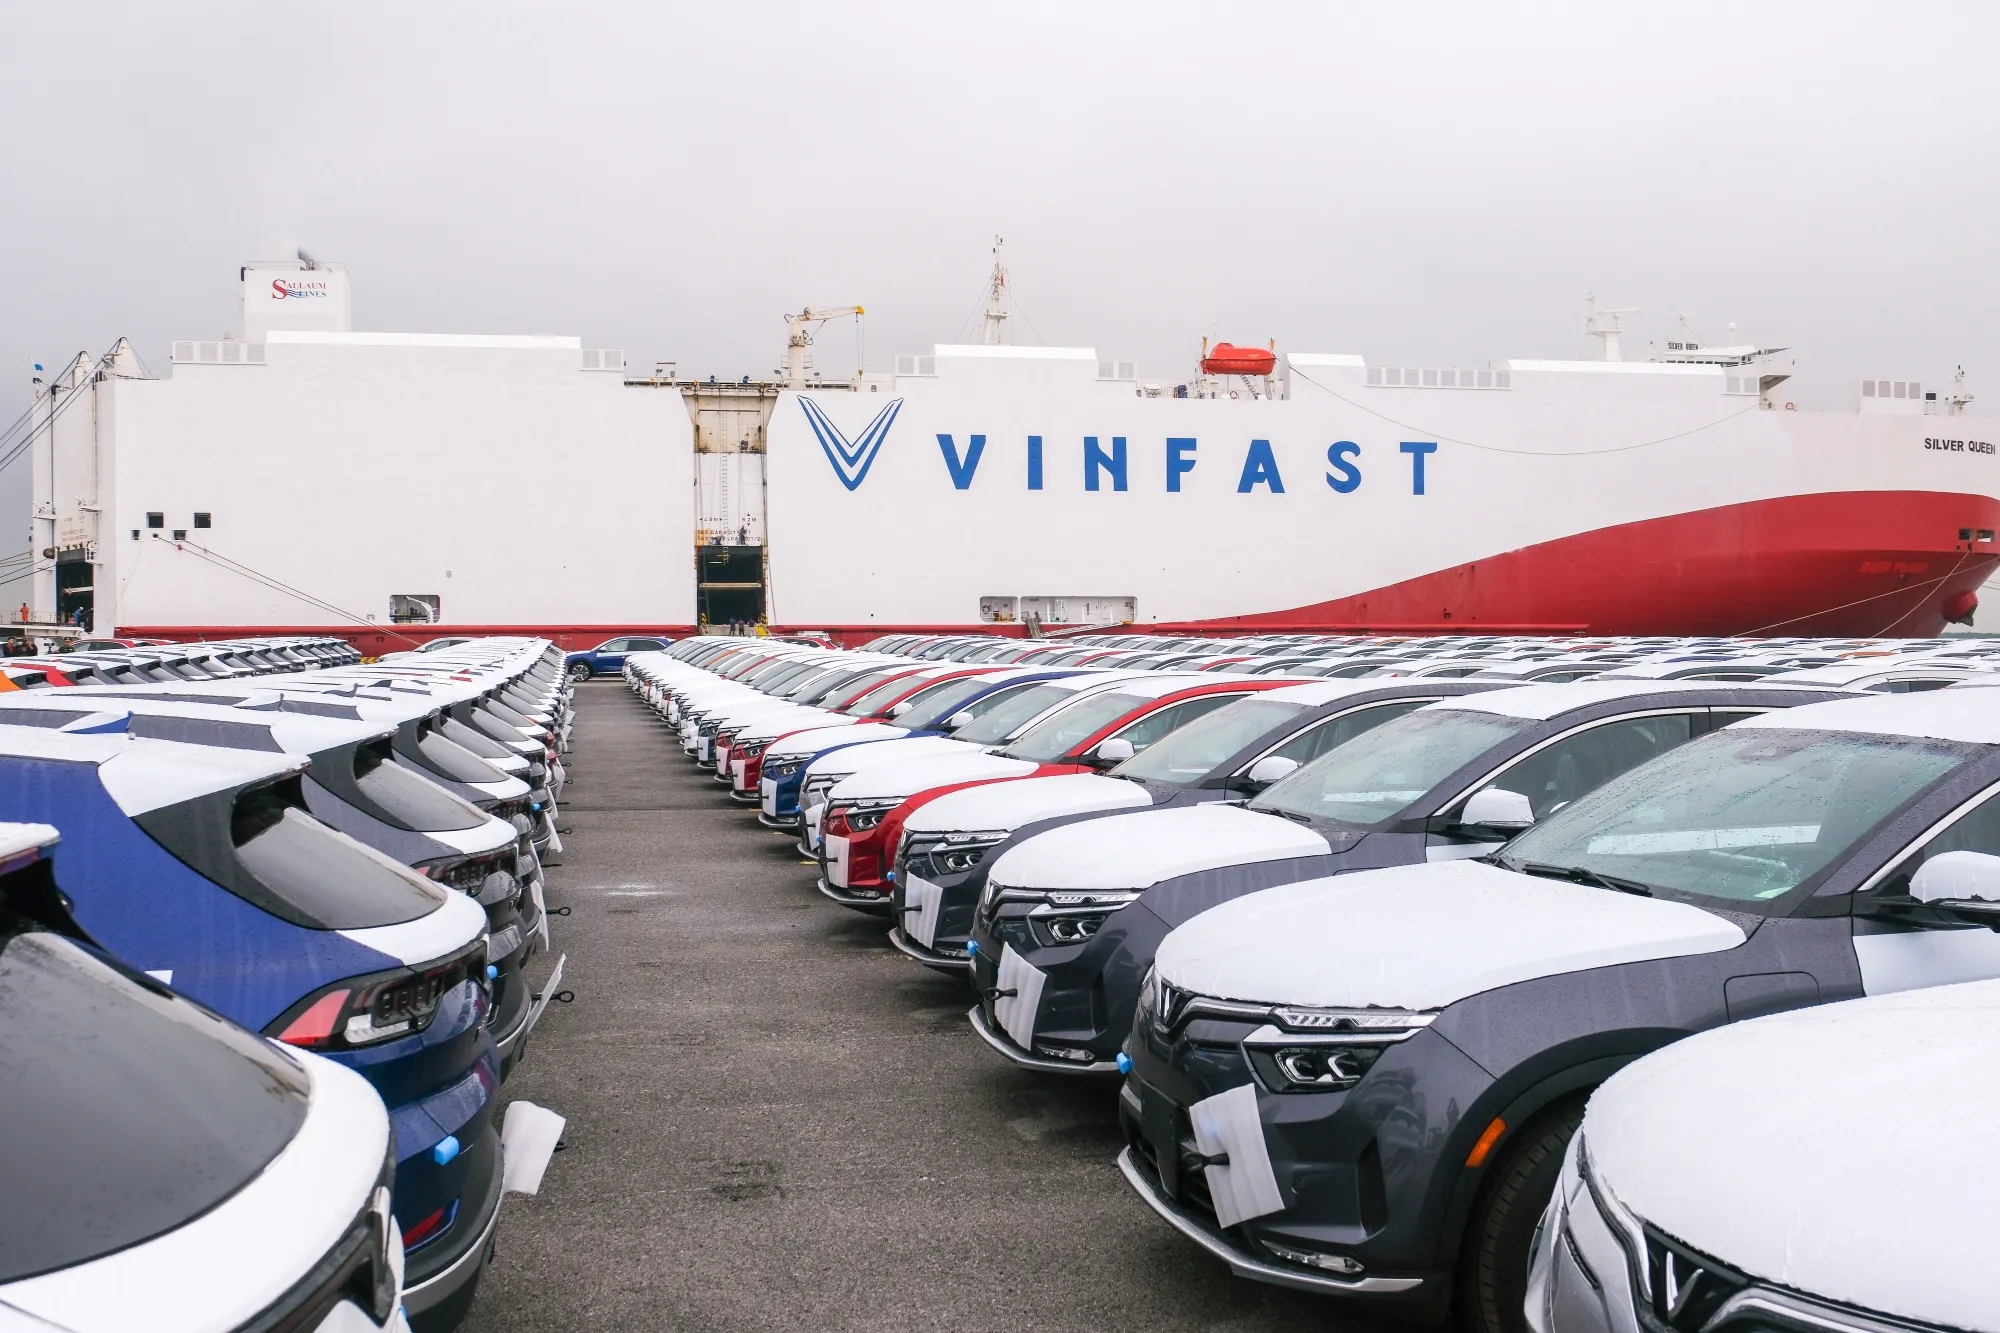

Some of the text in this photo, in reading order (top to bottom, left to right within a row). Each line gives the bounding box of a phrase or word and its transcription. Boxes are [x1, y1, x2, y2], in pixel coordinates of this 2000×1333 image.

[272, 279, 326, 299] SALLAUM
[1924, 438, 1996, 455] SILVER QUEEN
[936, 434, 1438, 495] VINFAST
